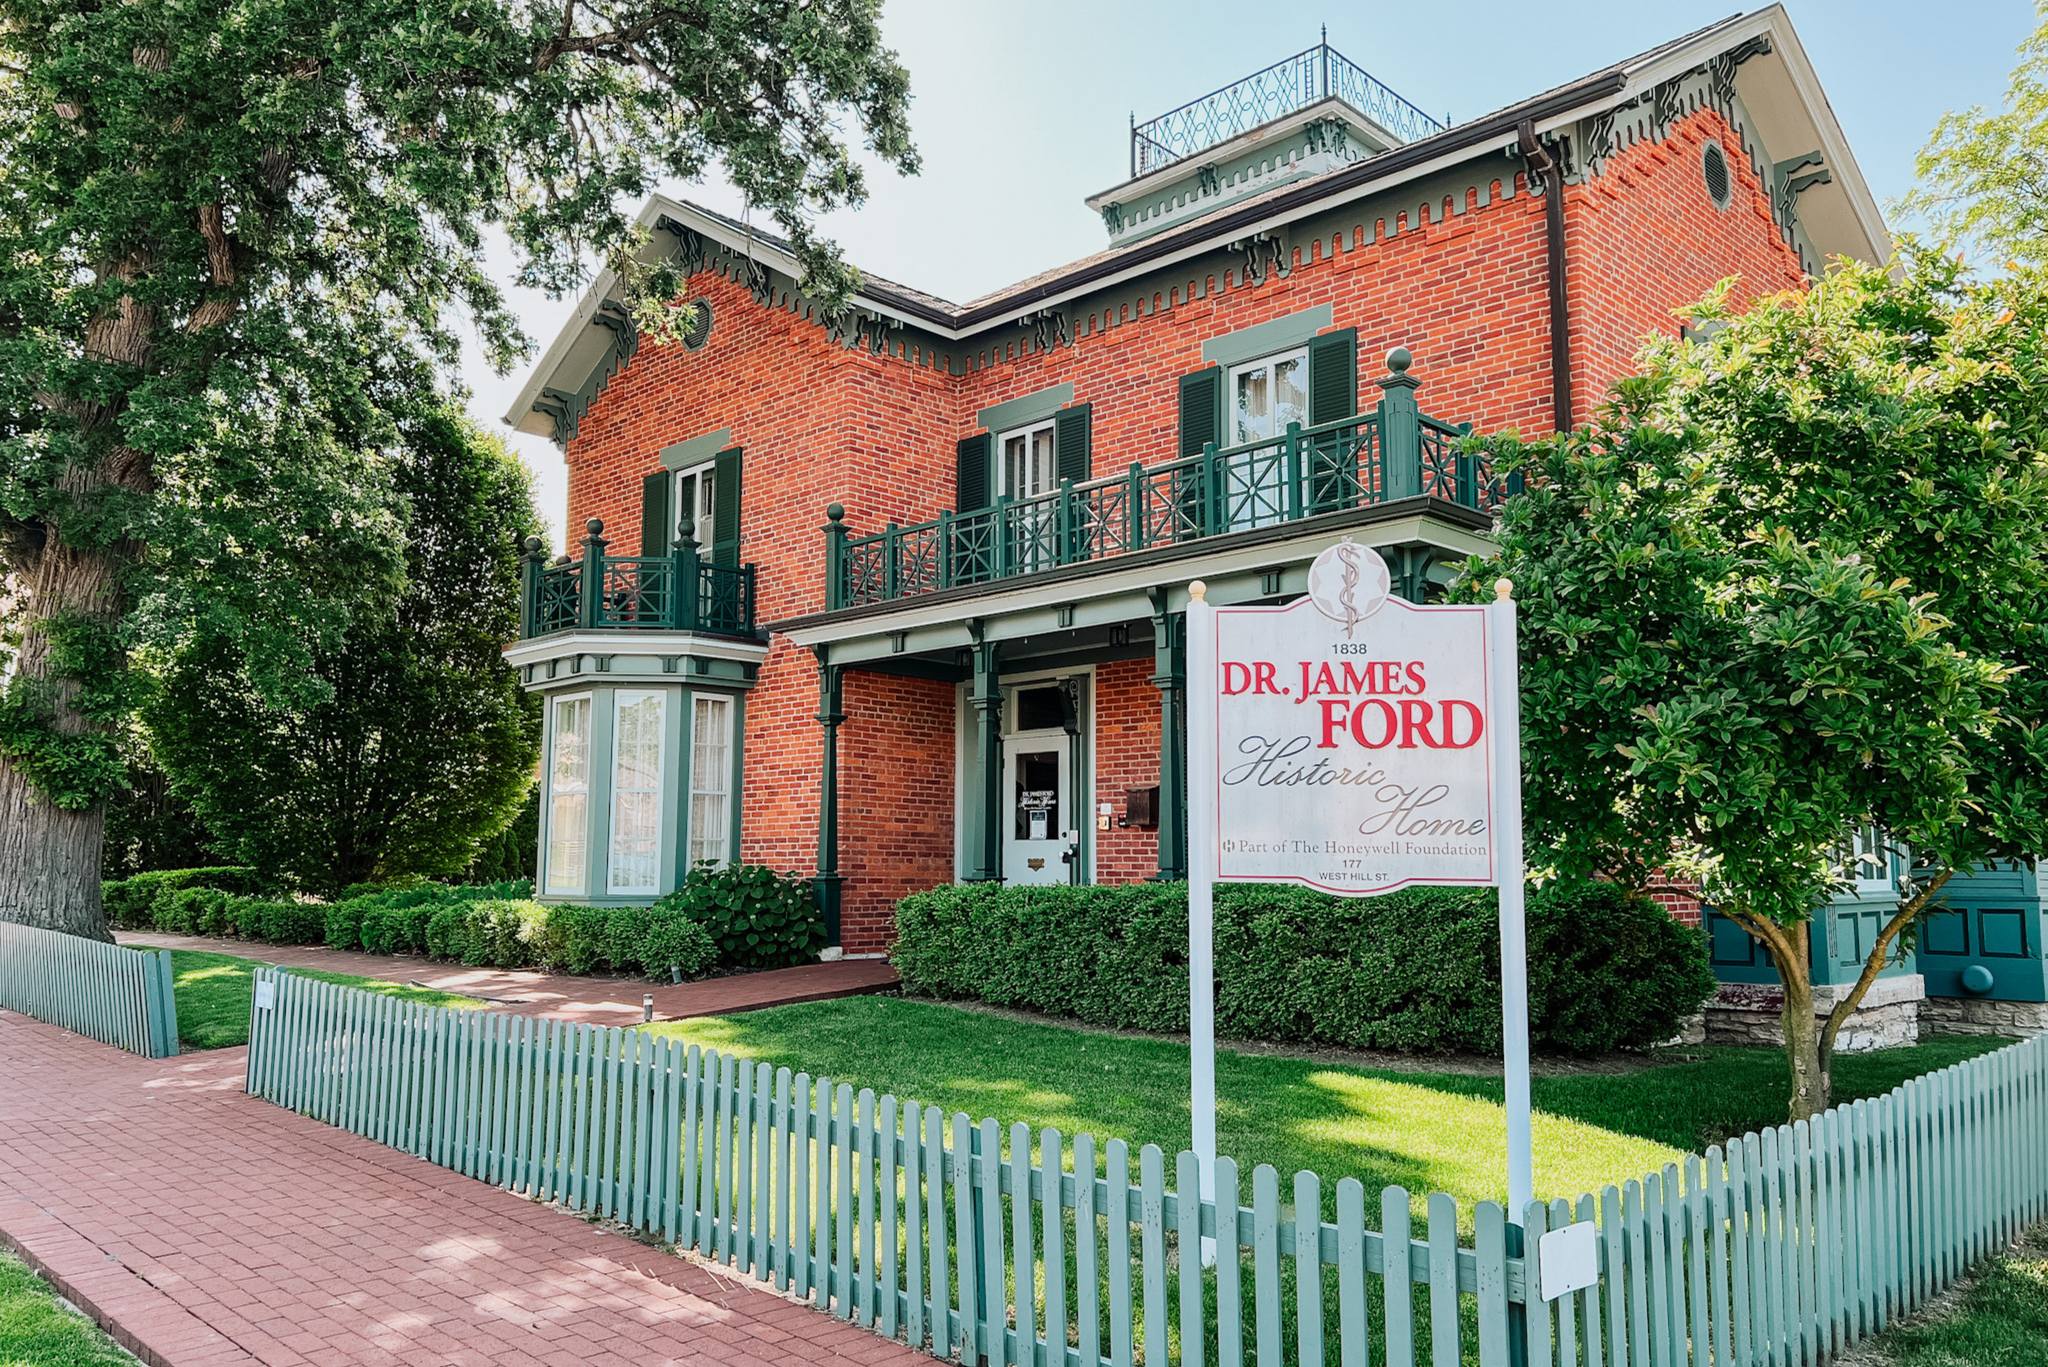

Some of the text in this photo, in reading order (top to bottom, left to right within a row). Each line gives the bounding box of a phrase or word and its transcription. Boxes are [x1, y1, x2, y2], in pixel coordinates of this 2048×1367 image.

[1332, 643, 1367, 655] 1838
[1221, 660, 1426, 704] DR. JAMES
[1317, 698, 1484, 749] FORD
[1222, 735, 1387, 787] Historic
[1358, 784, 1487, 836] Home
[1239, 840, 1487, 857] Part of The Honeywell Foundation
[1319, 872, 1390, 882] WEST HILL ST.
[1343, 859, 1362, 869] 177
